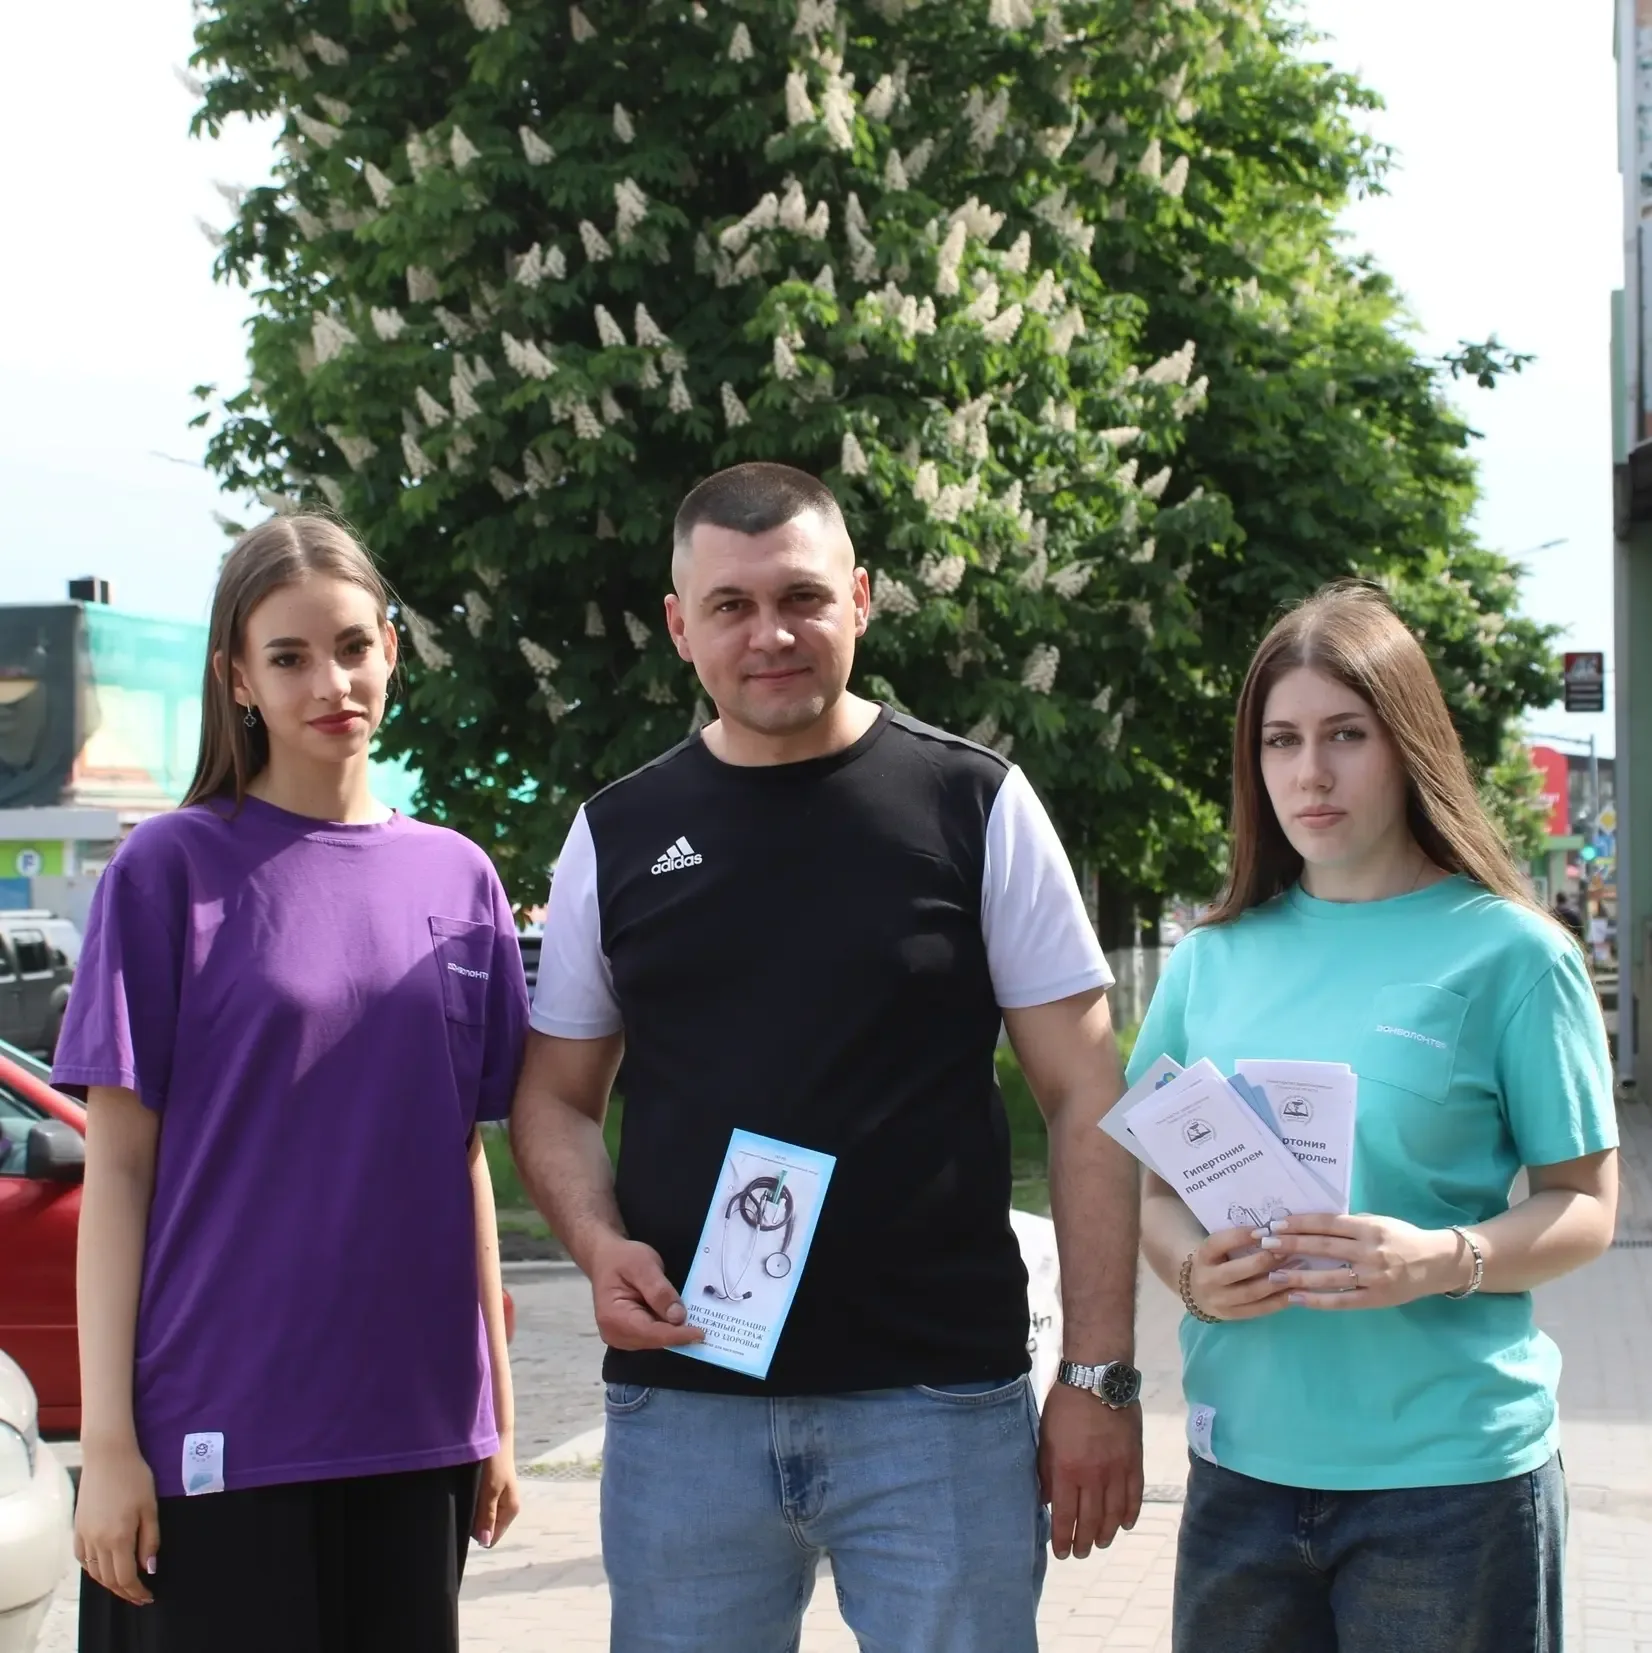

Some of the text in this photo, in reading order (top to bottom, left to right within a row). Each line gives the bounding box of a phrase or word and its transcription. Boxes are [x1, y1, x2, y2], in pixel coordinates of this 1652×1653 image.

[651, 853, 703, 875] adidas
[1282, 1137, 1327, 1150] ртония
[1182, 1143, 1246, 1180] Гипертония
[1291, 1151, 1337, 1165] тролем
[1185, 1149, 1264, 1194] под контролем
[687, 1304, 767, 1333] ДИСПАНСЕРИЗАЦИЯ
[689, 1313, 764, 1341] НАДЕЖНЫЙ СТРАЖ
[722, 1334, 760, 1350] ЗДОРОВЬЯ
